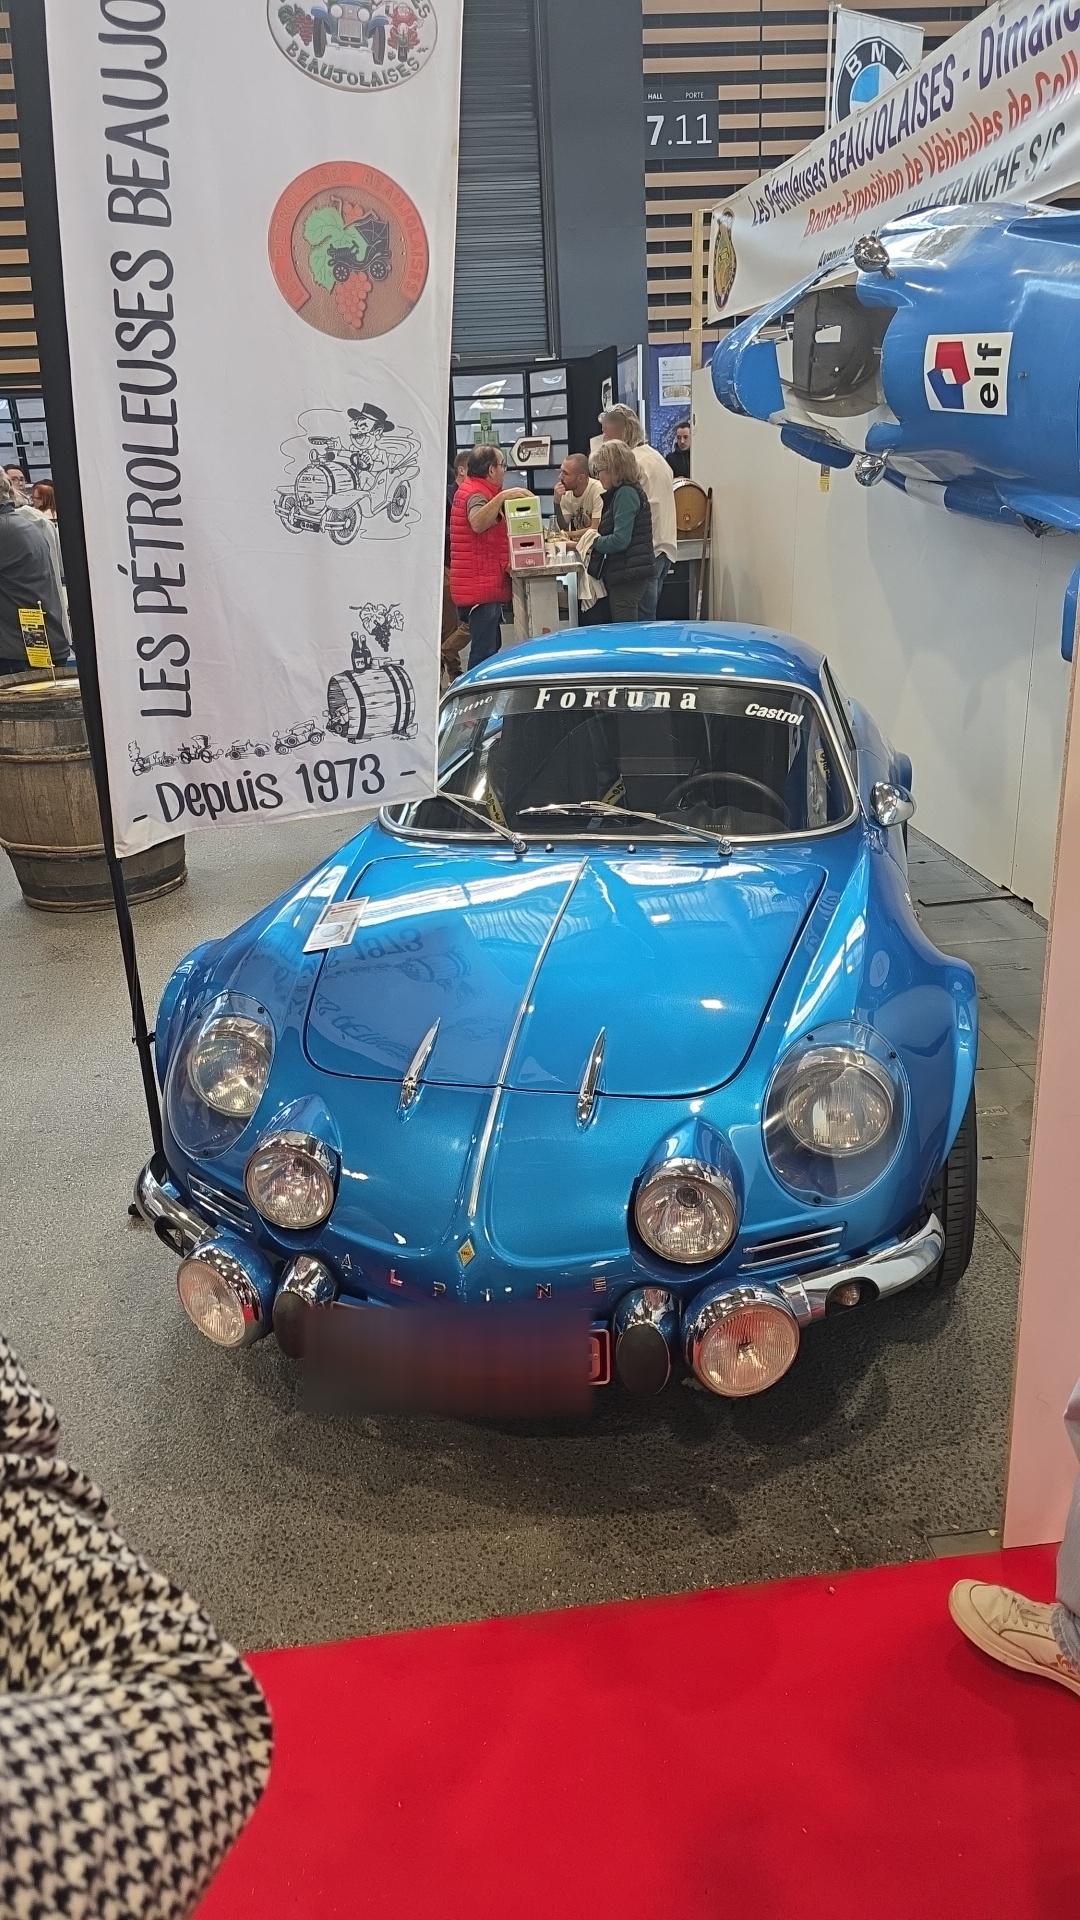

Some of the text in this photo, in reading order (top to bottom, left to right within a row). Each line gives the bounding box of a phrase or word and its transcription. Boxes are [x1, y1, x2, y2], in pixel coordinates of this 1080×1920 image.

[286, 40, 420, 88] BEAUJOLAISES
[685, 91, 704, 99] PORTE
[646, 113, 713, 146] 7.11
[747, 195, 771, 228] Les
[763, 156, 828, 219] Pétroleuses
[828, 53, 956, 184] BEAUJOLAISES
[803, 168, 904, 238] Bourse-Exposition
[902, 153, 924, 190] de
[917, 109, 1004, 179] Véhicules
[1007, 88, 1032, 132] de
[97, 0, 192, 718] LES PÉTROLEUSES BEAUJO
[973, 342, 1002, 408] elf
[533, 686, 698, 711] Fortuna
[744, 702, 805, 726] Castrol
[155, 769, 283, 824] Depuis
[294, 753, 386, 804] 1973
